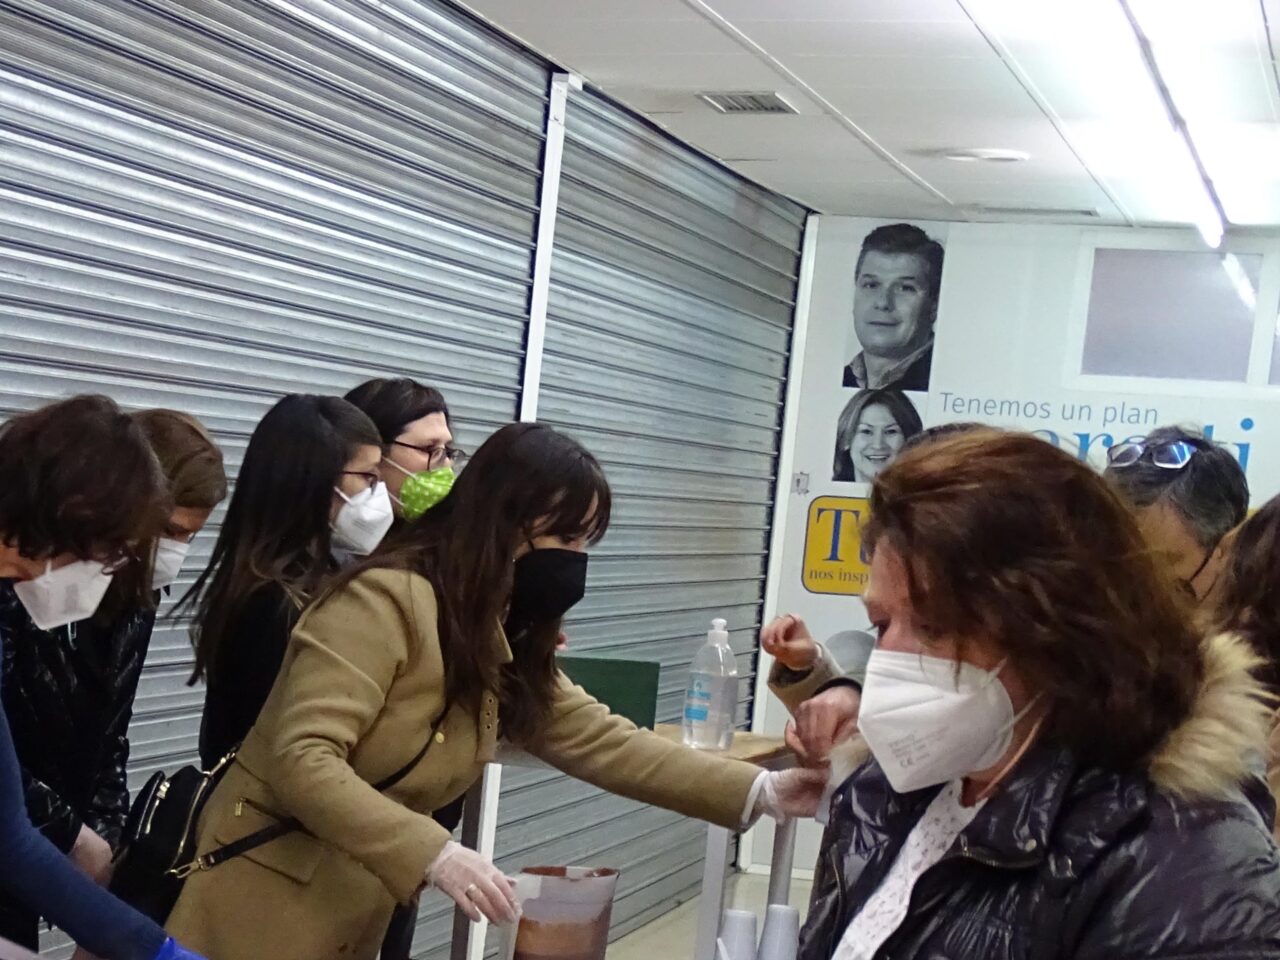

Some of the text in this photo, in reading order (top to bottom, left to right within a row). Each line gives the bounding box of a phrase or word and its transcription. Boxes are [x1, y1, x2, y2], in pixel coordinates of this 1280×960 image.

[939, 391, 1158, 428] Tenemos un plan
[816, 507, 874, 566] T
[809, 568, 869, 585] nos insp
